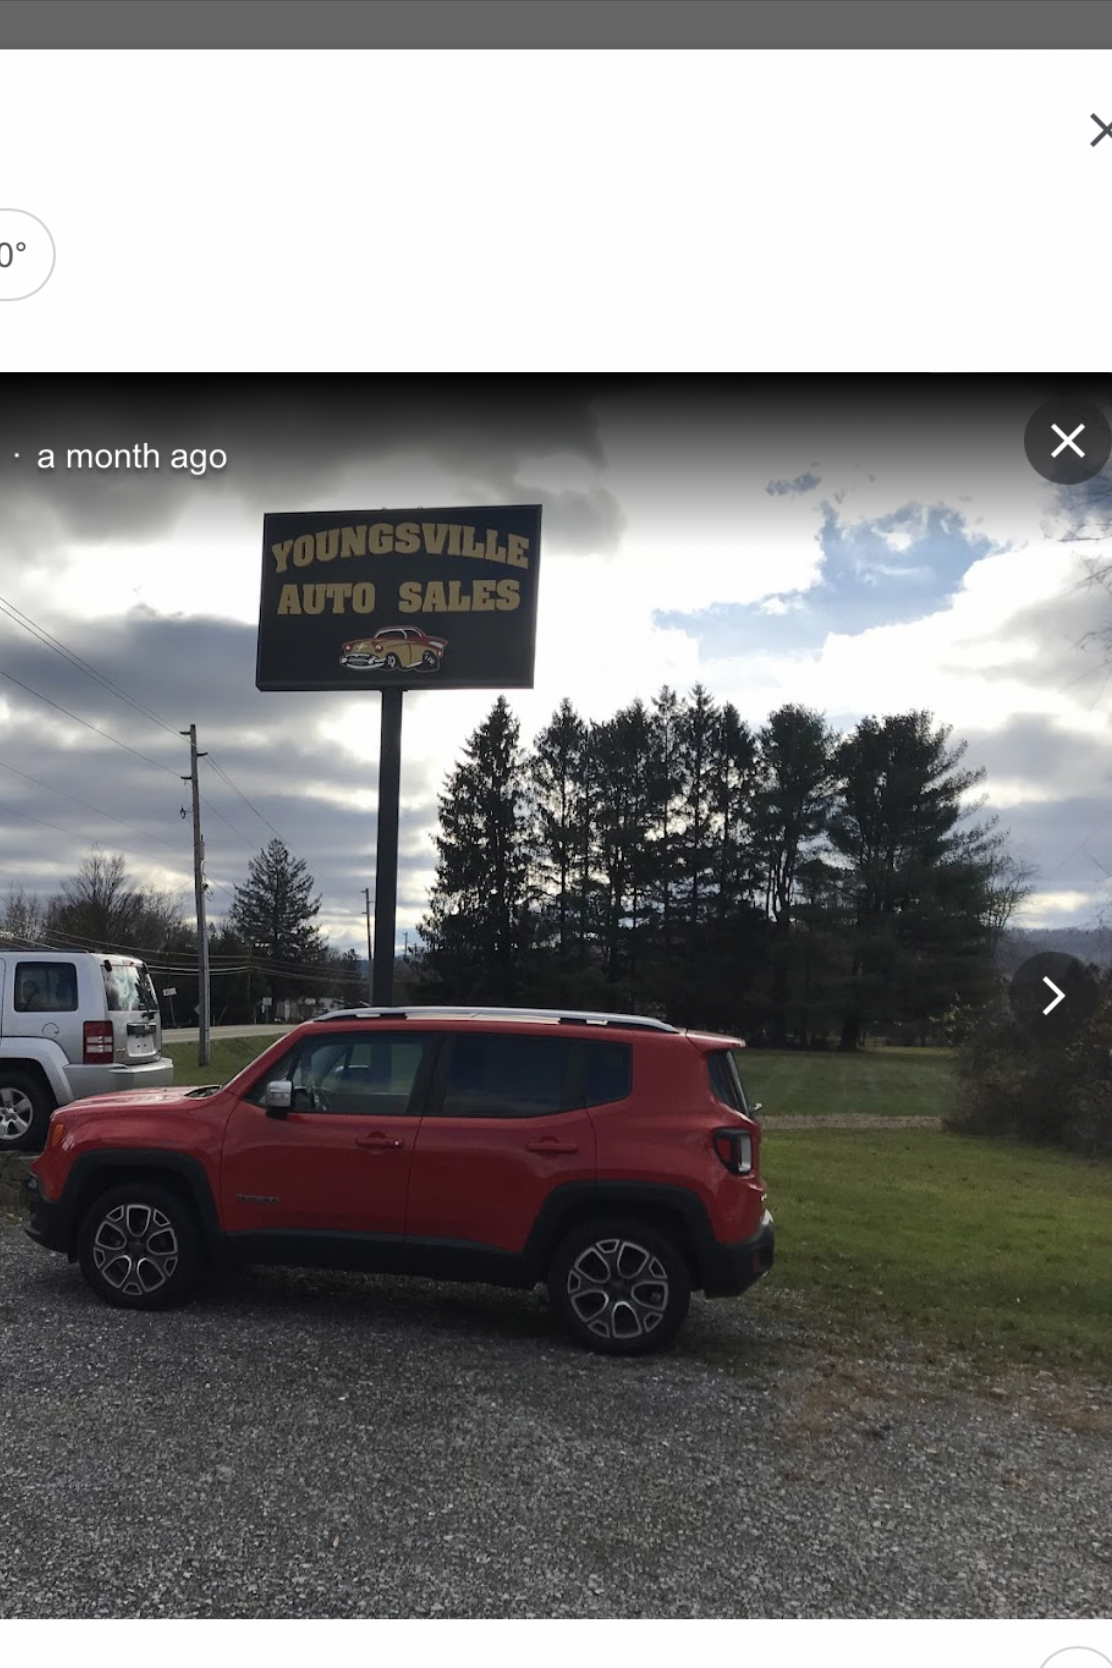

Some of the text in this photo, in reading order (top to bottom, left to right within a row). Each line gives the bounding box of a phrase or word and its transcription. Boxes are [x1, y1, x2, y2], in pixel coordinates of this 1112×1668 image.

[272, 522, 530, 574] YOUNGSVILLE
[277, 579, 520, 615] AUTO SALES
